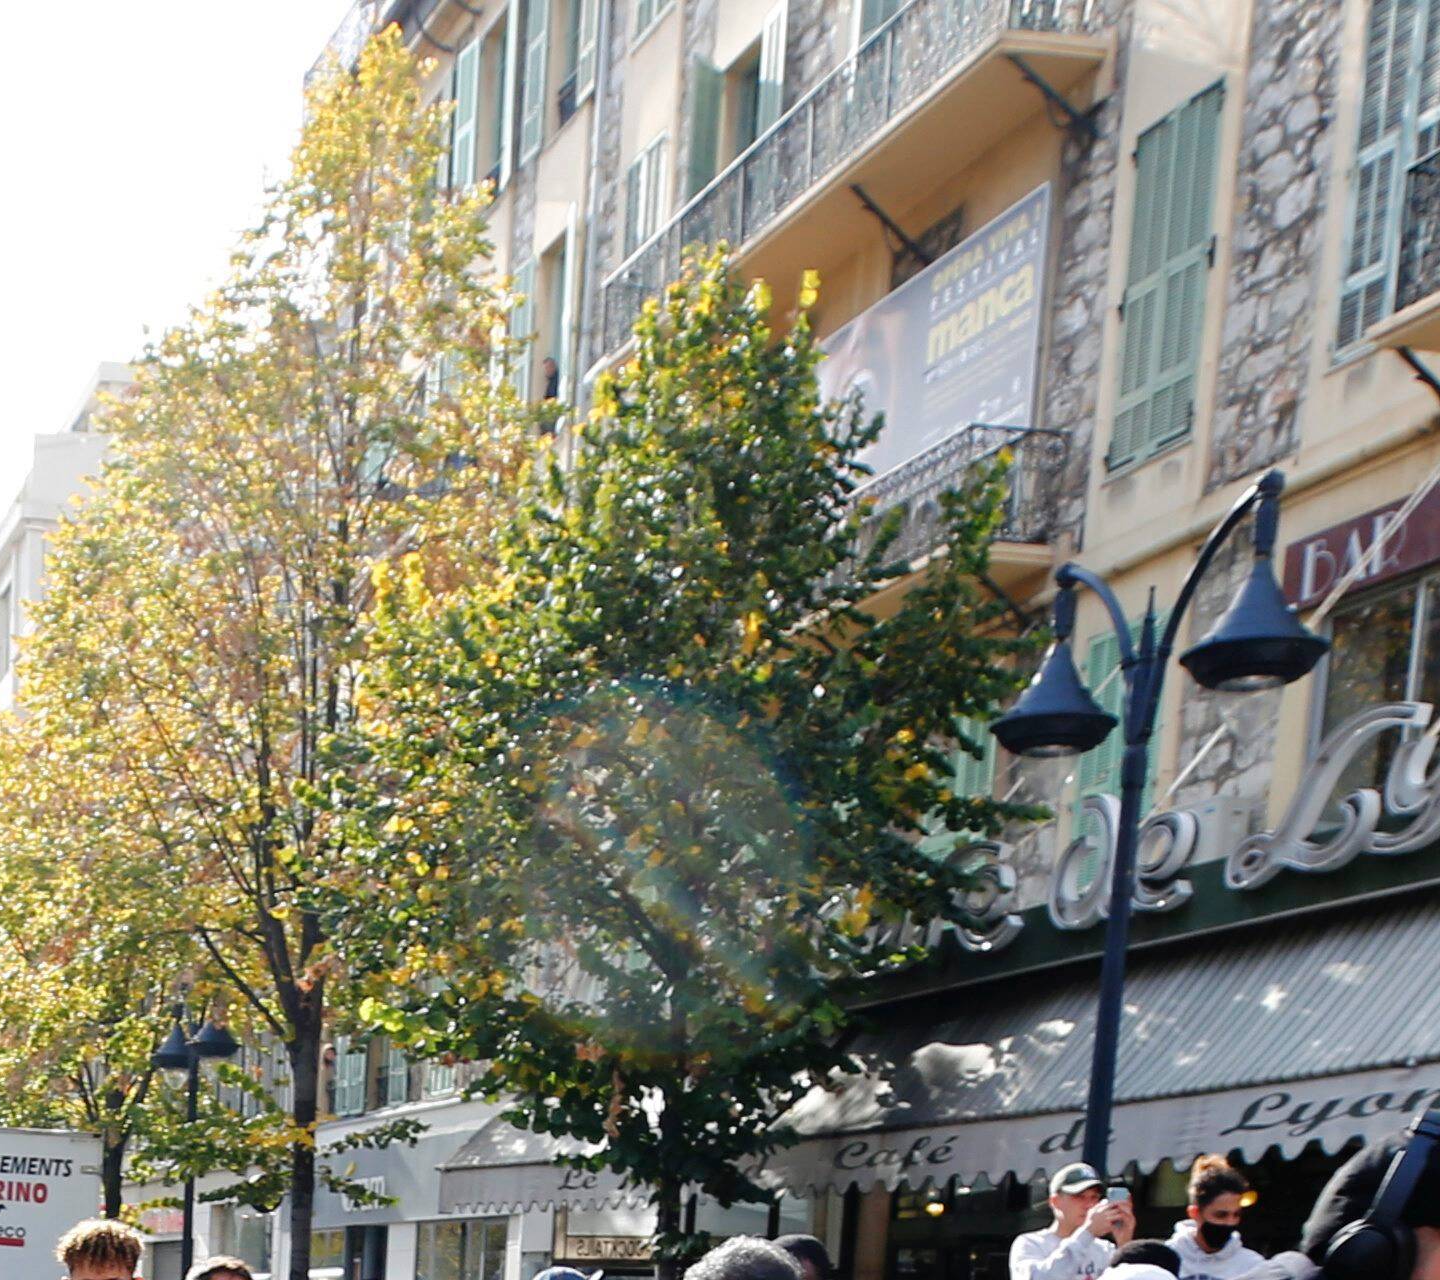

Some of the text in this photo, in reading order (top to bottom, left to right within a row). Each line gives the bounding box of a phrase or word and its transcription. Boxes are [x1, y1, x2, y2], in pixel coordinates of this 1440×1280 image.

[926, 263, 1034, 365] manca
[929, 227, 1038, 313] FESTIVAL
[1300, 509, 1409, 601] BAR
[832, 1134, 961, 1175] Café
